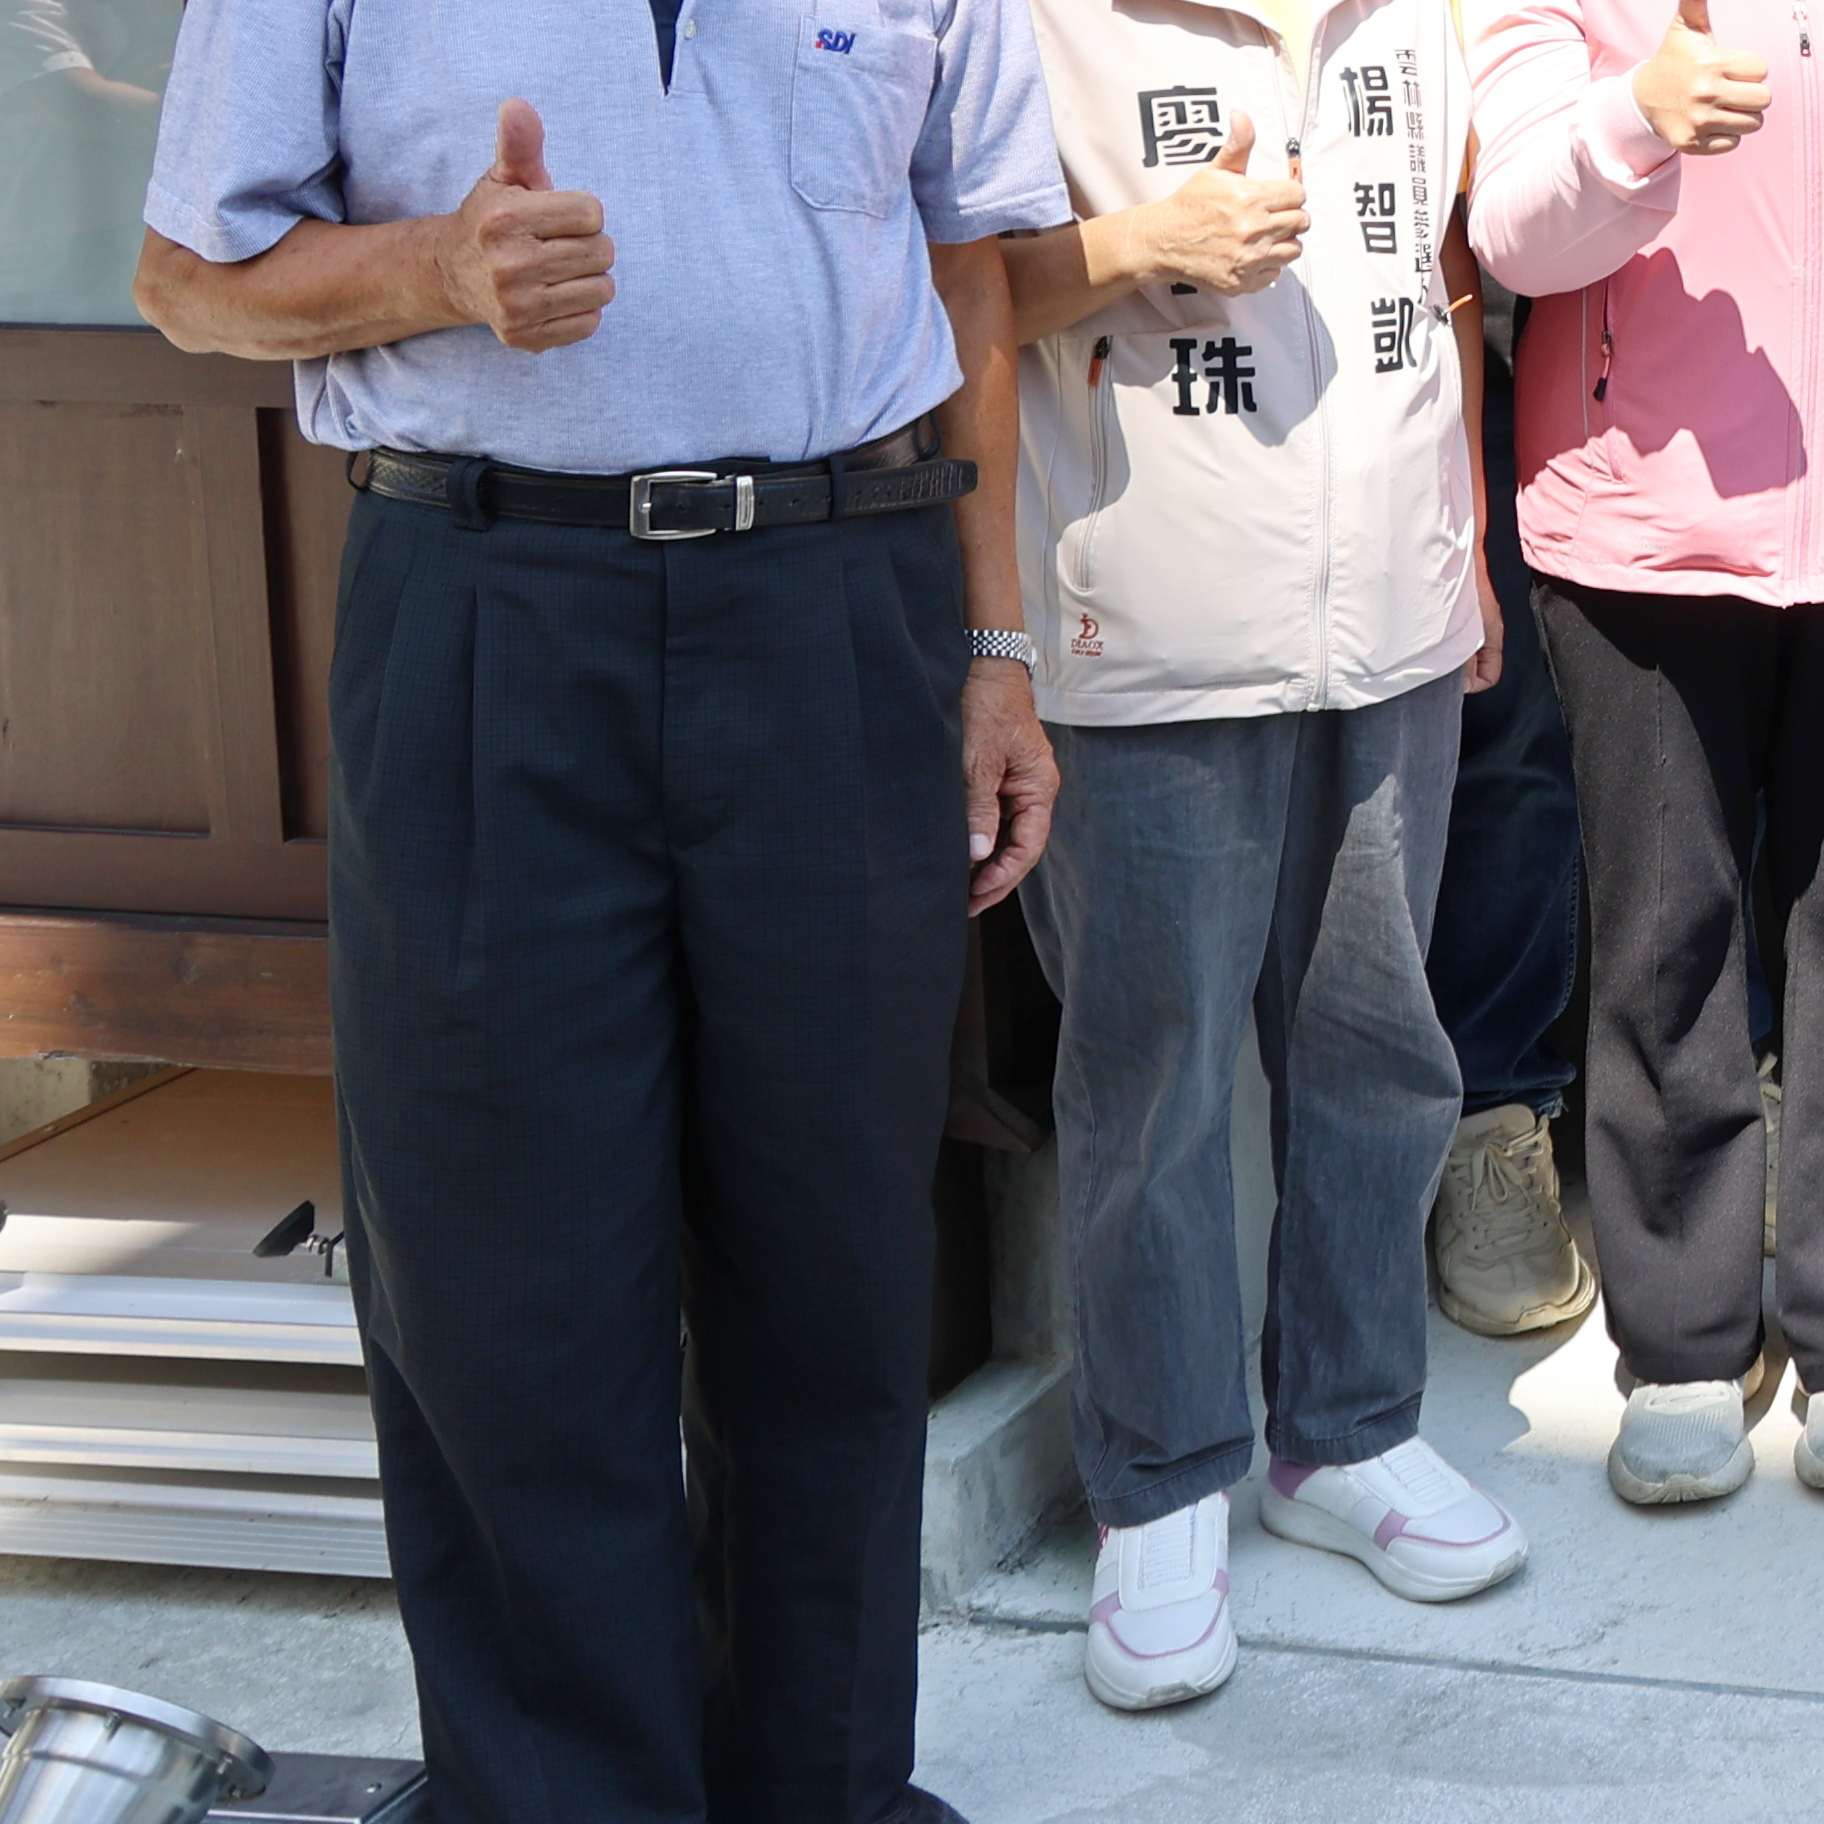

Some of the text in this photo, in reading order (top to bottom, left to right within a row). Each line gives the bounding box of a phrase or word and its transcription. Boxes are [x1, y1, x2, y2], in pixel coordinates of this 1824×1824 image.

[817, 28, 856, 55] SDI
[1137, 84, 1257, 416] 廖珠
[1338, 64, 1418, 374] 楊智凱
